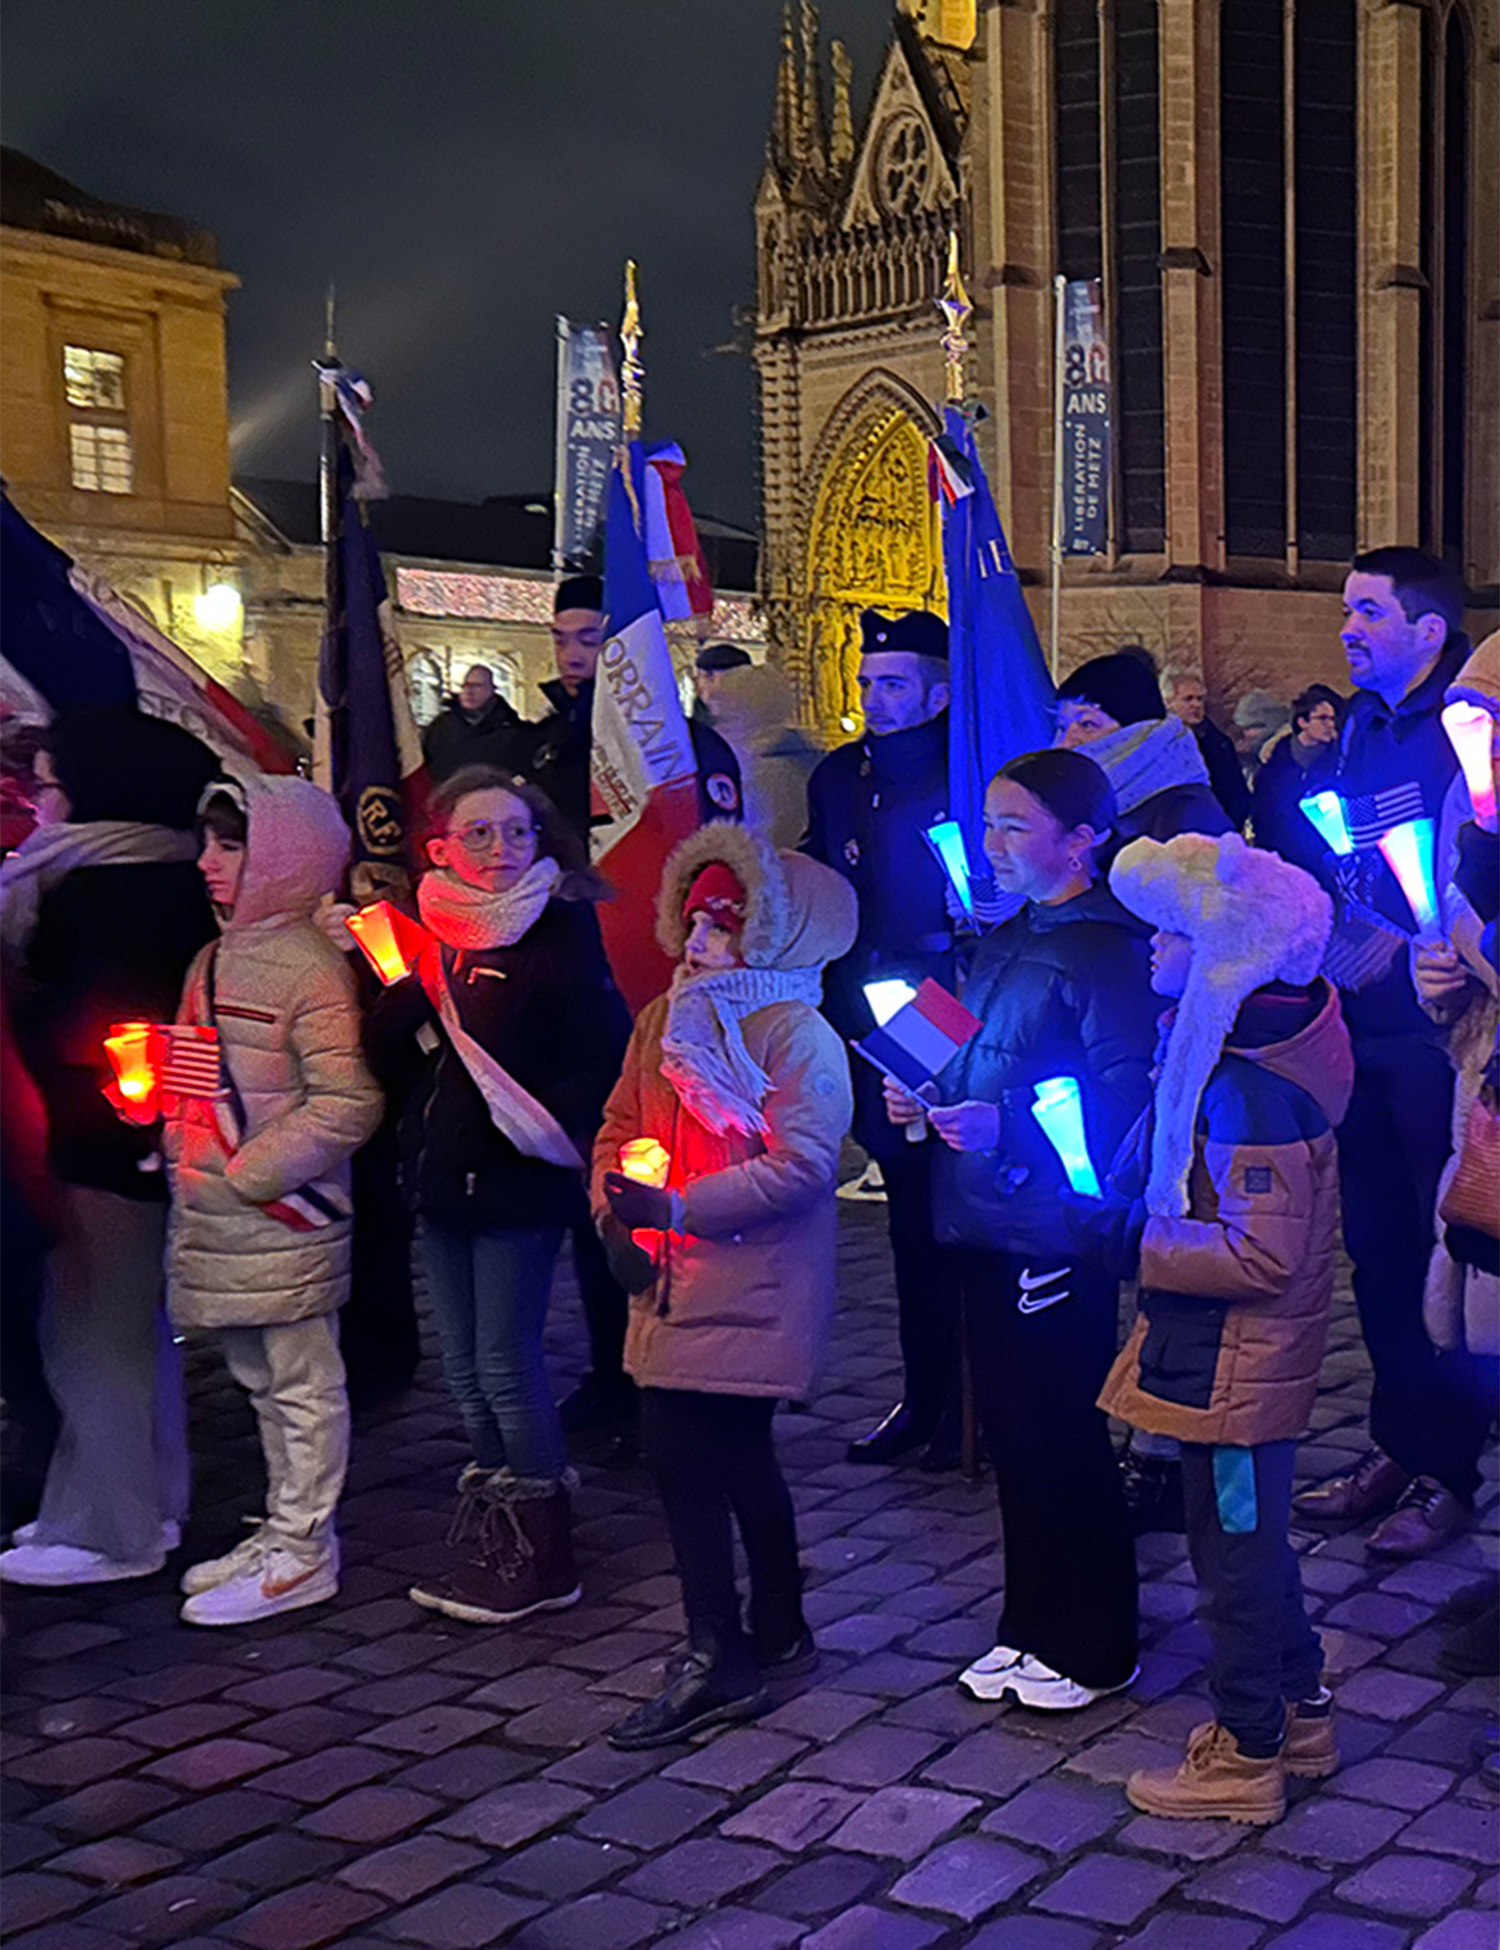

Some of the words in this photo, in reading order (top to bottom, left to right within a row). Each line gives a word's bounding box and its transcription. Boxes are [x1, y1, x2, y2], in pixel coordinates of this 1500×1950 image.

[1065, 343, 1106, 384] 80
[1067, 392, 1106, 414] ANS
[570, 419, 616, 441] ANS
[1087, 437, 1102, 490] METZ
[1087, 494, 1098, 519] DE
